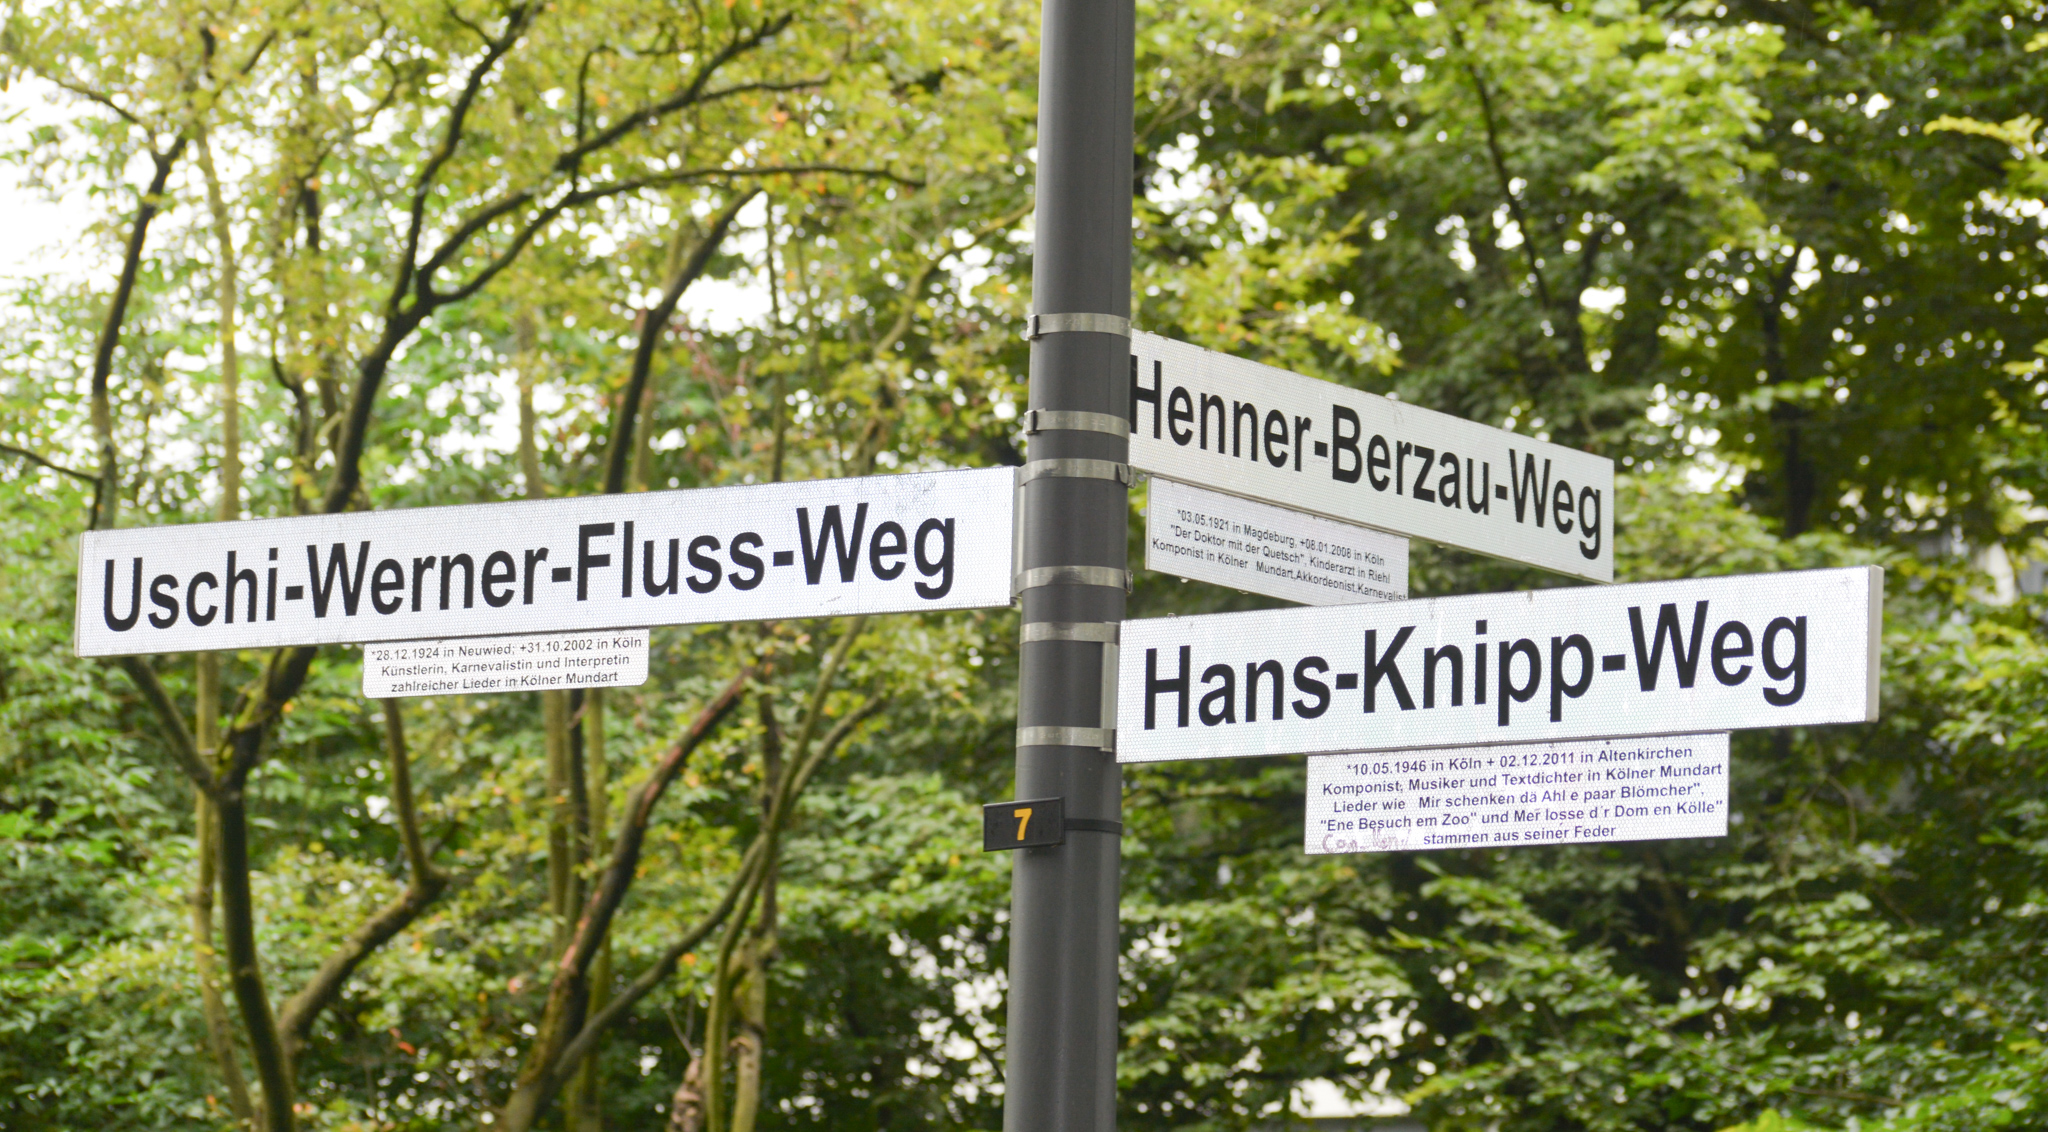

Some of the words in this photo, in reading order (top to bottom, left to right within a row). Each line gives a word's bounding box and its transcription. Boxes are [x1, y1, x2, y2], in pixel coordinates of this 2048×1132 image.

[1130, 355, 1602, 560] Henner-Berzau-Weg
[1152, 537, 1204, 561] Komponist
[1206, 549, 1216, 562] in
[1217, 551, 1249, 569] Kölner
[1170, 524, 1192, 540] "Der
[1194, 530, 1226, 548] Doktor
[1228, 537, 1243, 551] mit
[1245, 541, 1260, 555] der
[1309, 555, 1356, 577] Kinderarzt
[1357, 566, 1366, 579] in
[1368, 568, 1391, 585] Riehl
[1232, 522, 1242, 534] in
[1244, 524, 1298, 549] Magdeburg,
[1300, 539, 1352, 559] +08.01.2008
[1353, 549, 1363, 561] in
[1364, 551, 1385, 567] Köln
[102, 502, 956, 633] Uschi-Werner-Fluss-Weg
[443, 646, 455, 658] in
[519, 639, 593, 654] +31.10.2002
[596, 638, 608, 650] in
[612, 636, 642, 649] Köln
[381, 662, 448, 677] Künstlerin,
[451, 659, 533, 674] Karnevalistin
[536, 656, 561, 670] und
[564, 654, 631, 671] Interpretin
[1144, 600, 1808, 731] Hans-Knipp-Weg
[391, 679, 459, 693] zahlreicher
[463, 677, 502, 690] Lieder
[505, 676, 517, 688] in
[520, 674, 563, 687] Kölner
[565, 671, 619, 684] Mundart
[1431, 759, 1444, 772] in
[1449, 757, 1482, 771] Köln
[1486, 757, 1495, 767] +
[1500, 751, 1575, 768] 02.12.2011
[1580, 750, 1593, 763] in
[1597, 746, 1693, 762] Altenkirchen
[1408, 776, 1465, 791] Musiker
[1469, 774, 1497, 788] und
[1501, 771, 1583, 786] Textdichter
[1587, 769, 1600, 782] in
[1606, 766, 1656, 781] Kölner
[1659, 763, 1722, 778] Mundart
[1320, 819, 1354, 832] "Ene
[1358, 815, 1412, 830] Besuch
[1416, 815, 1438, 828] em
[1441, 811, 1477, 826] Zoo"
[1481, 811, 1509, 824] und
[1513, 809, 1541, 822] Mer
[1545, 807, 1585, 821] losse
[1614, 804, 1649, 818] Dom
[1653, 803, 1672, 816] en
[1676, 799, 1724, 815] Kölle"
[1333, 799, 1378, 813] Lieder
[1382, 798, 1406, 811] wie
[1418, 796, 1441, 809] Mir
[1445, 792, 1515, 807] schenken
[1519, 790, 1537, 803] dä
[1541, 789, 1566, 802] Ahl
[1570, 790, 1579, 801] e
[1583, 788, 1616, 804] paar
[1014, 808, 1032, 841] 7
[1423, 830, 1489, 845] stammen
[1493, 828, 1519, 842] aus
[1523, 827, 1570, 841] seiner
[1573, 824, 1617, 839] Feder
